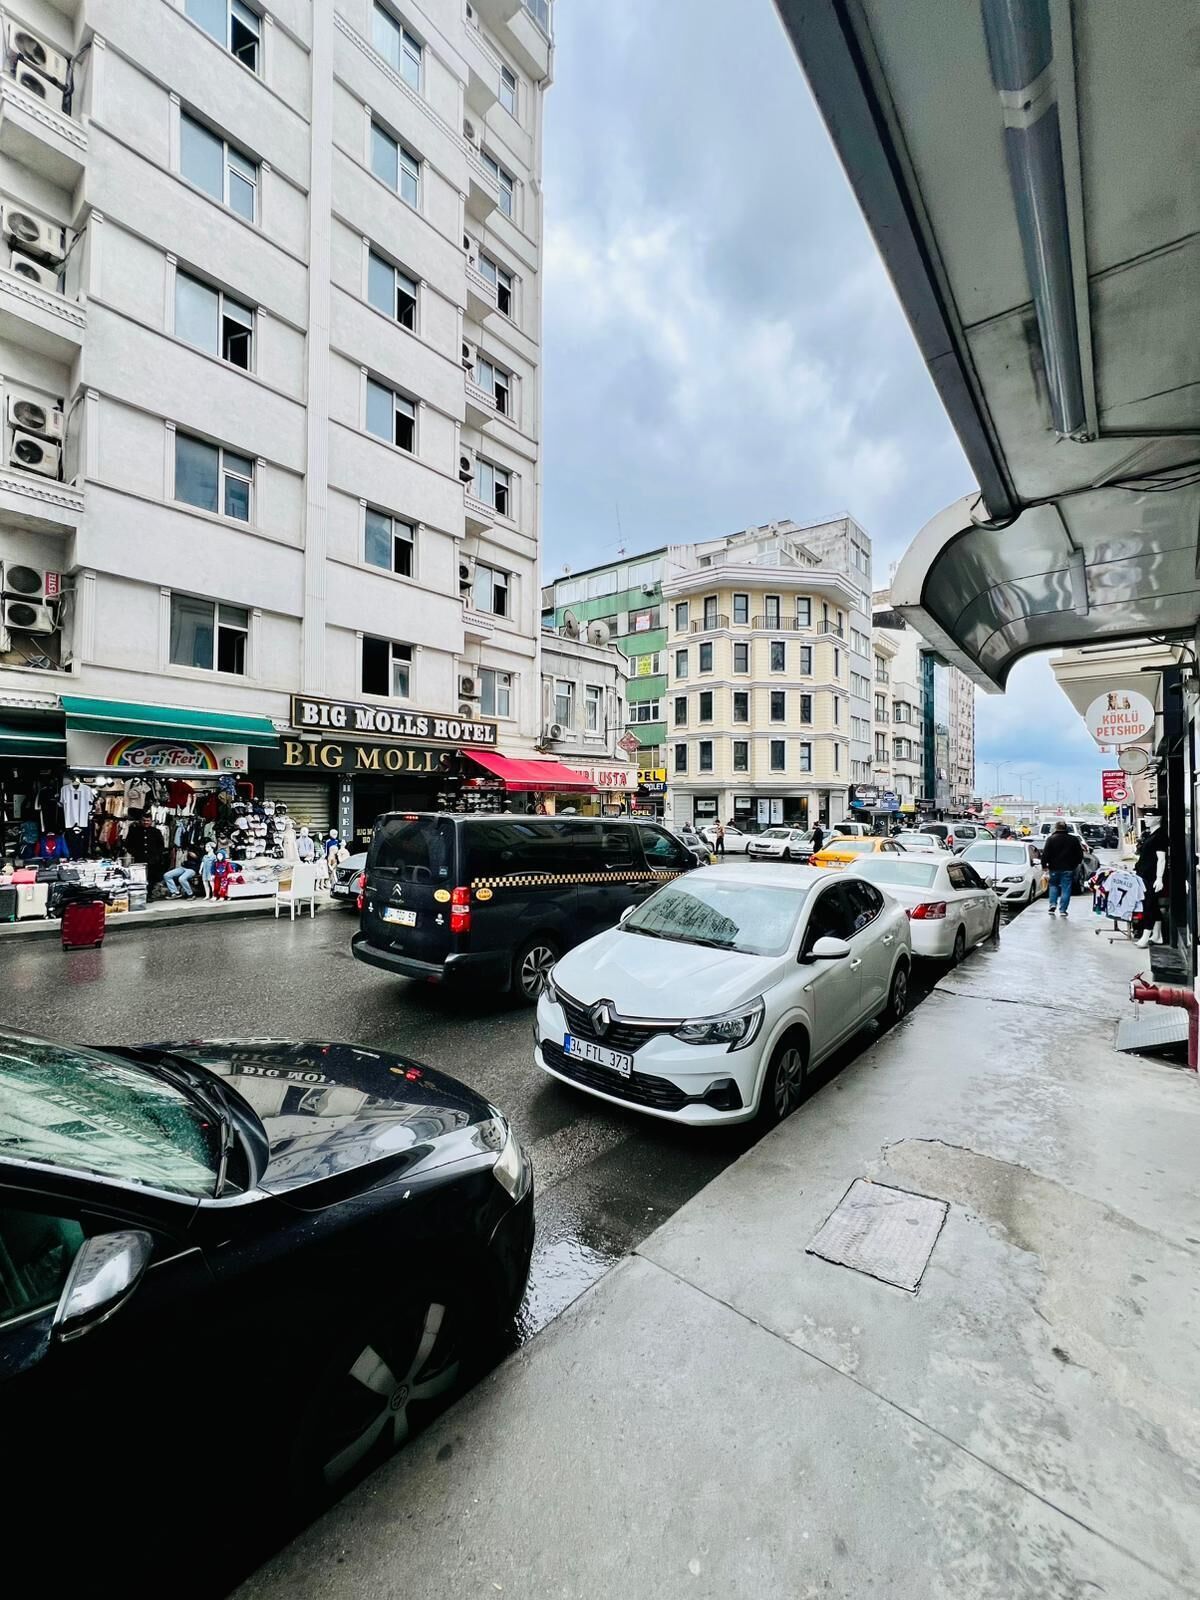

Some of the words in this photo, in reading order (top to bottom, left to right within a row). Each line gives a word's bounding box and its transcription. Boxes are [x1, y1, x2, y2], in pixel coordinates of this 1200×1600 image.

[301, 702, 347, 727] BIG
[355, 709, 429, 737] MOLLS
[434, 719, 494, 743] HOTEL
[1102, 710, 1139, 725] KÖKLÜ
[1096, 724, 1146, 737] PETSHOP
[283, 741, 344, 768] BIG
[355, 747, 450, 773] MOLLS
[637, 771, 660, 781] PEL
[341, 784, 351, 837] HOTEL
[1117, 887, 1129, 906] 7
[570, 1038, 582, 1055] 34
[586, 1044, 604, 1063] FTL
[609, 1052, 629, 1071] 373
